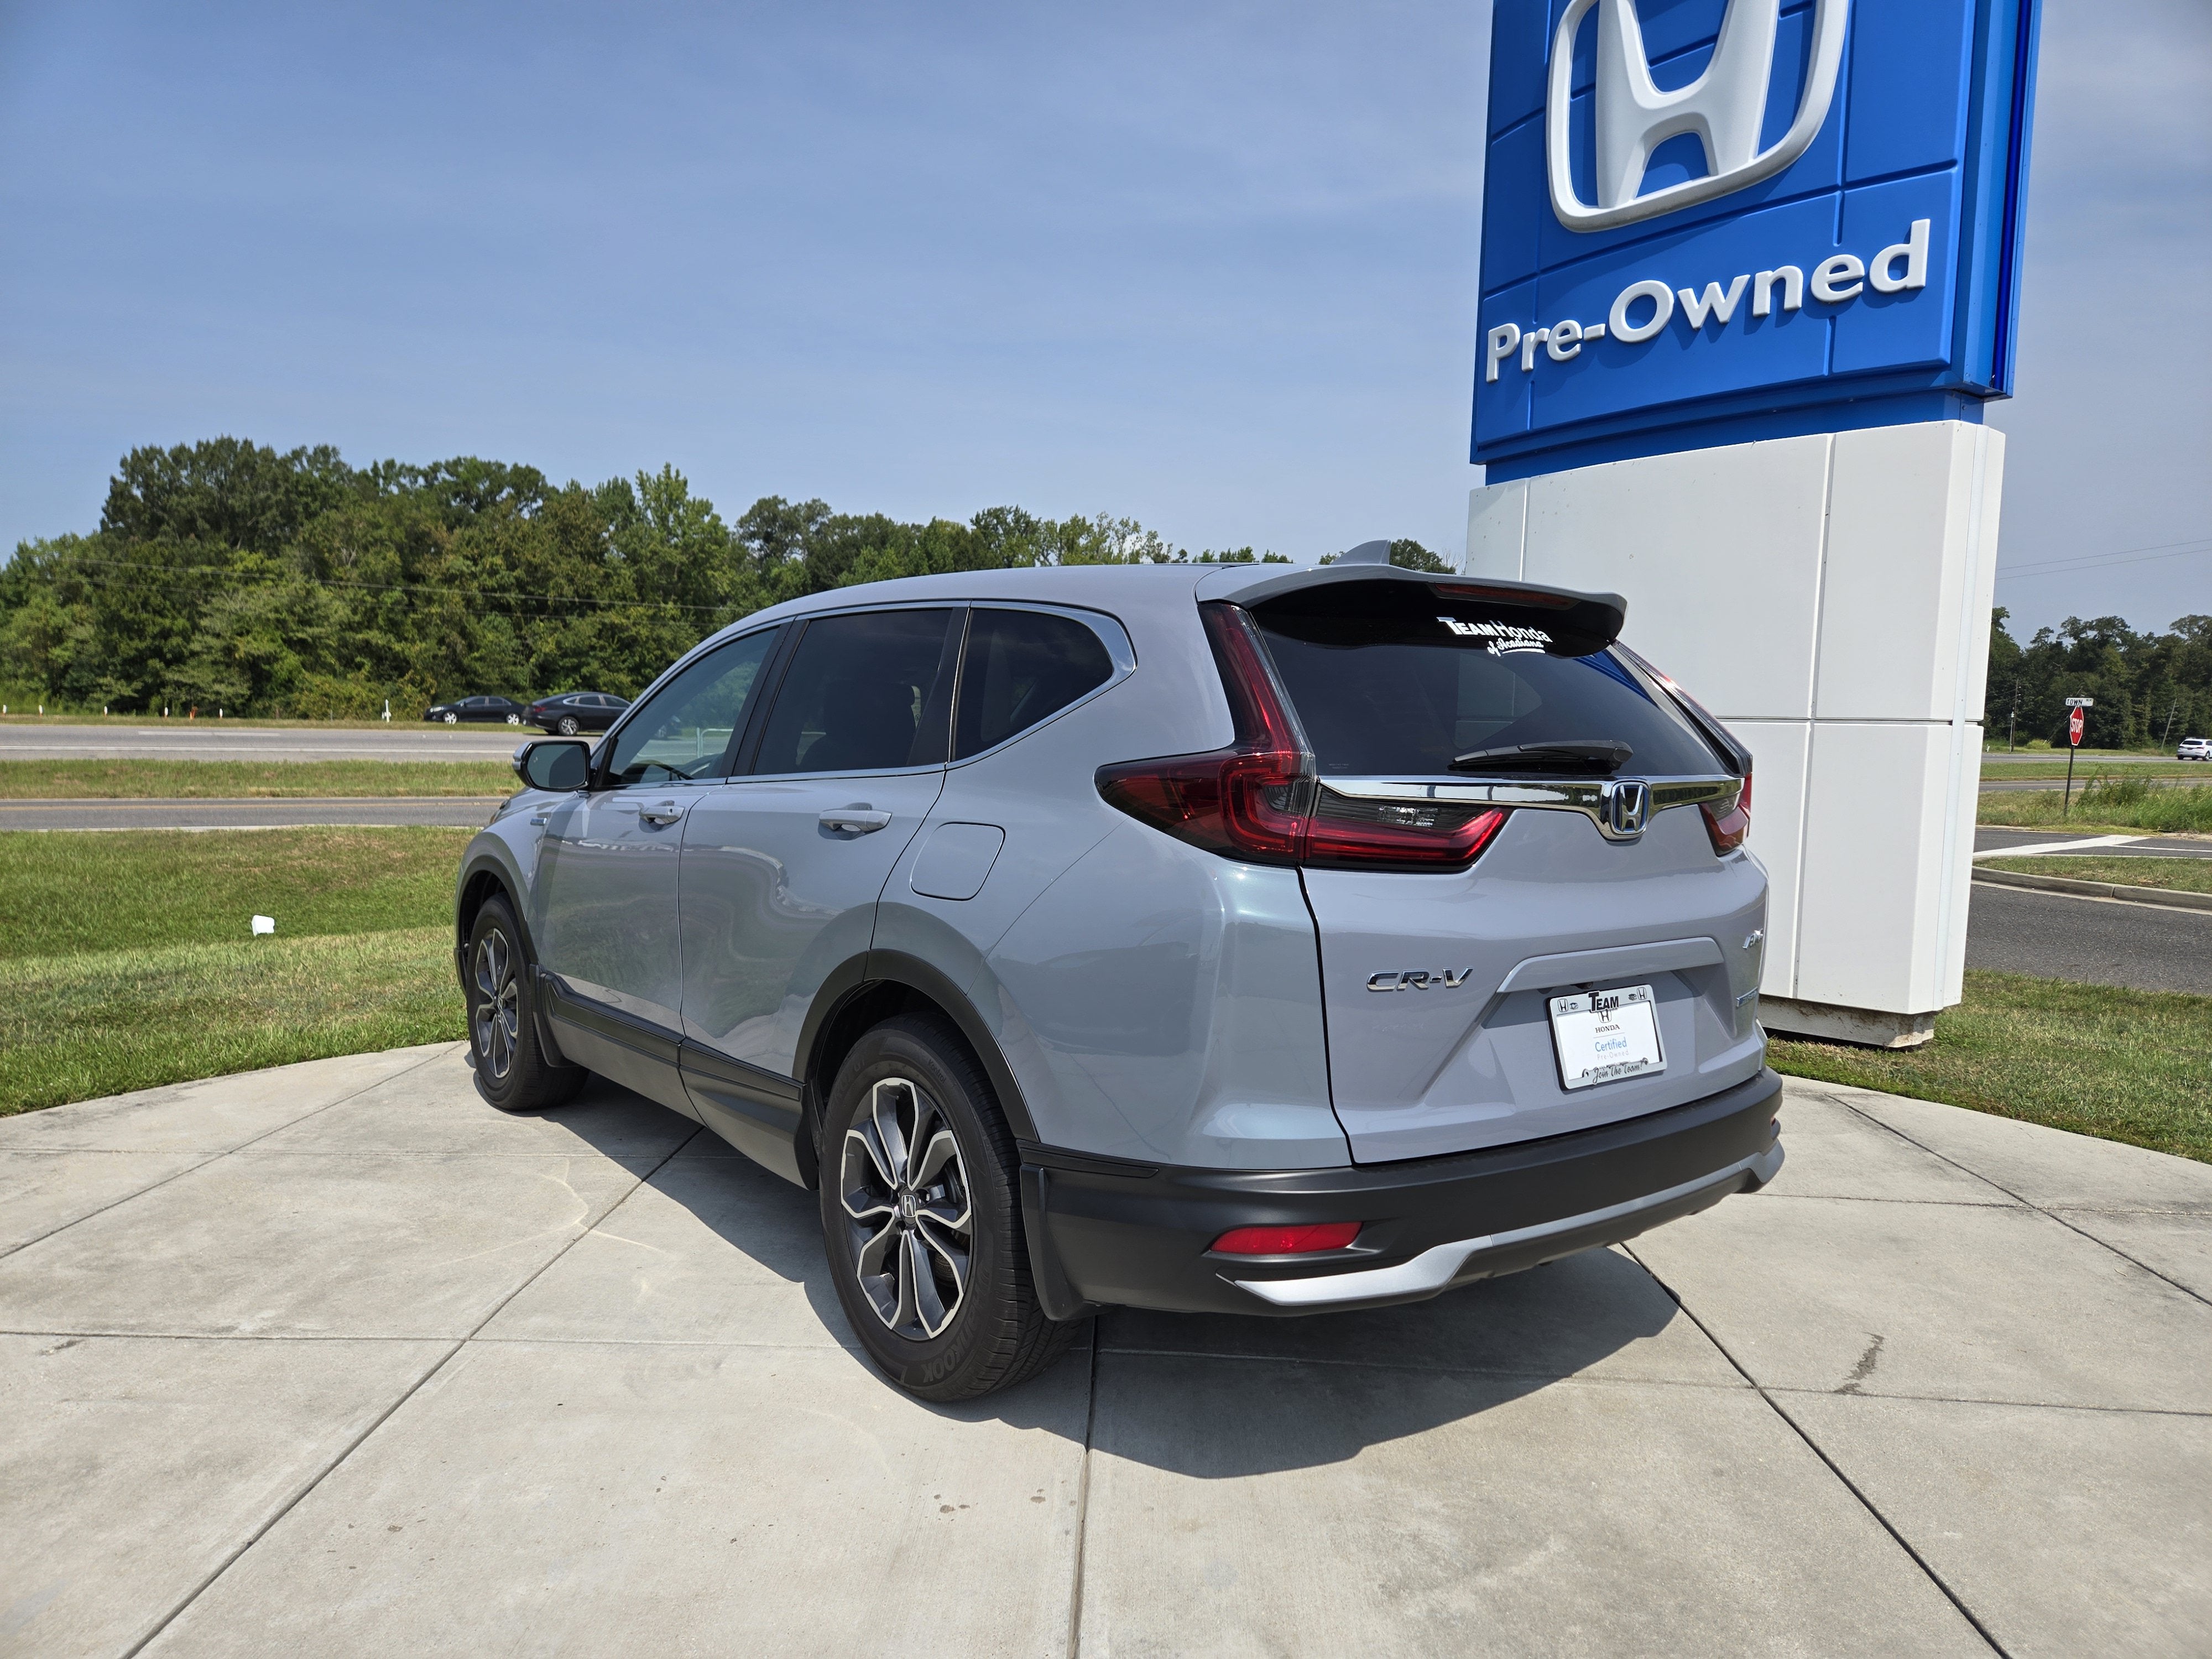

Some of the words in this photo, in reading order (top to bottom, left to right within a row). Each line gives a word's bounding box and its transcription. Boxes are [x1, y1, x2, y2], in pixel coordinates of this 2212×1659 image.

[1485, 218, 1931, 383] Pre-Owned
[1487, 640, 1501, 657] of
[2070, 718, 2083, 733] STOP
[1366, 967, 1474, 992] CR-V
[1588, 992, 1619, 1011] TEAM
[1595, 1024, 1620, 1033] HONDA
[1595, 1036, 1627, 1052] Certified
[1597, 1051, 1629, 1060] Pre-Owned
[1593, 1067, 1608, 1084] Join
